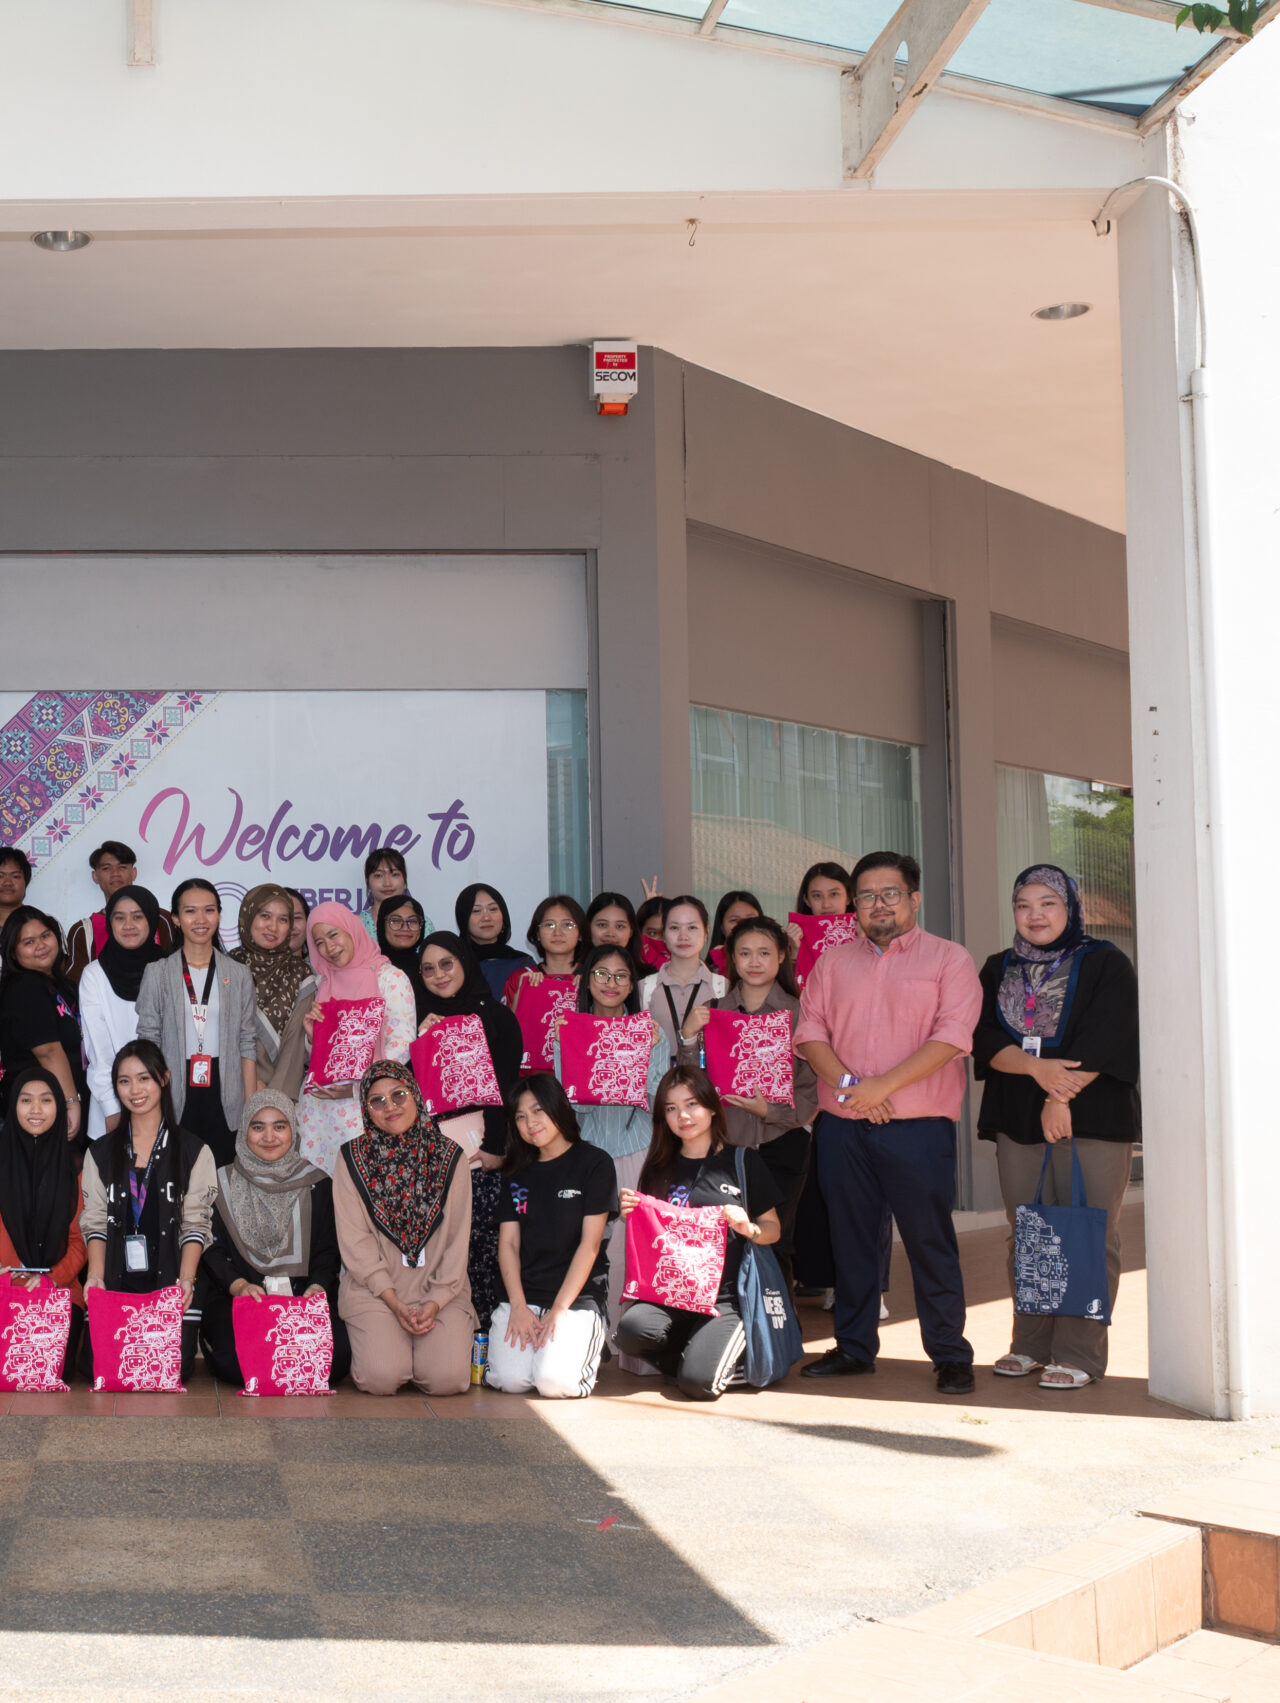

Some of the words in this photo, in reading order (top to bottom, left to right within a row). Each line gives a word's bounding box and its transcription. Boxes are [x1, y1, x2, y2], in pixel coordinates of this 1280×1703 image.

[595, 371, 636, 382] SECOM
[138, 786, 422, 876] Welcome
[427, 798, 475, 871] to
